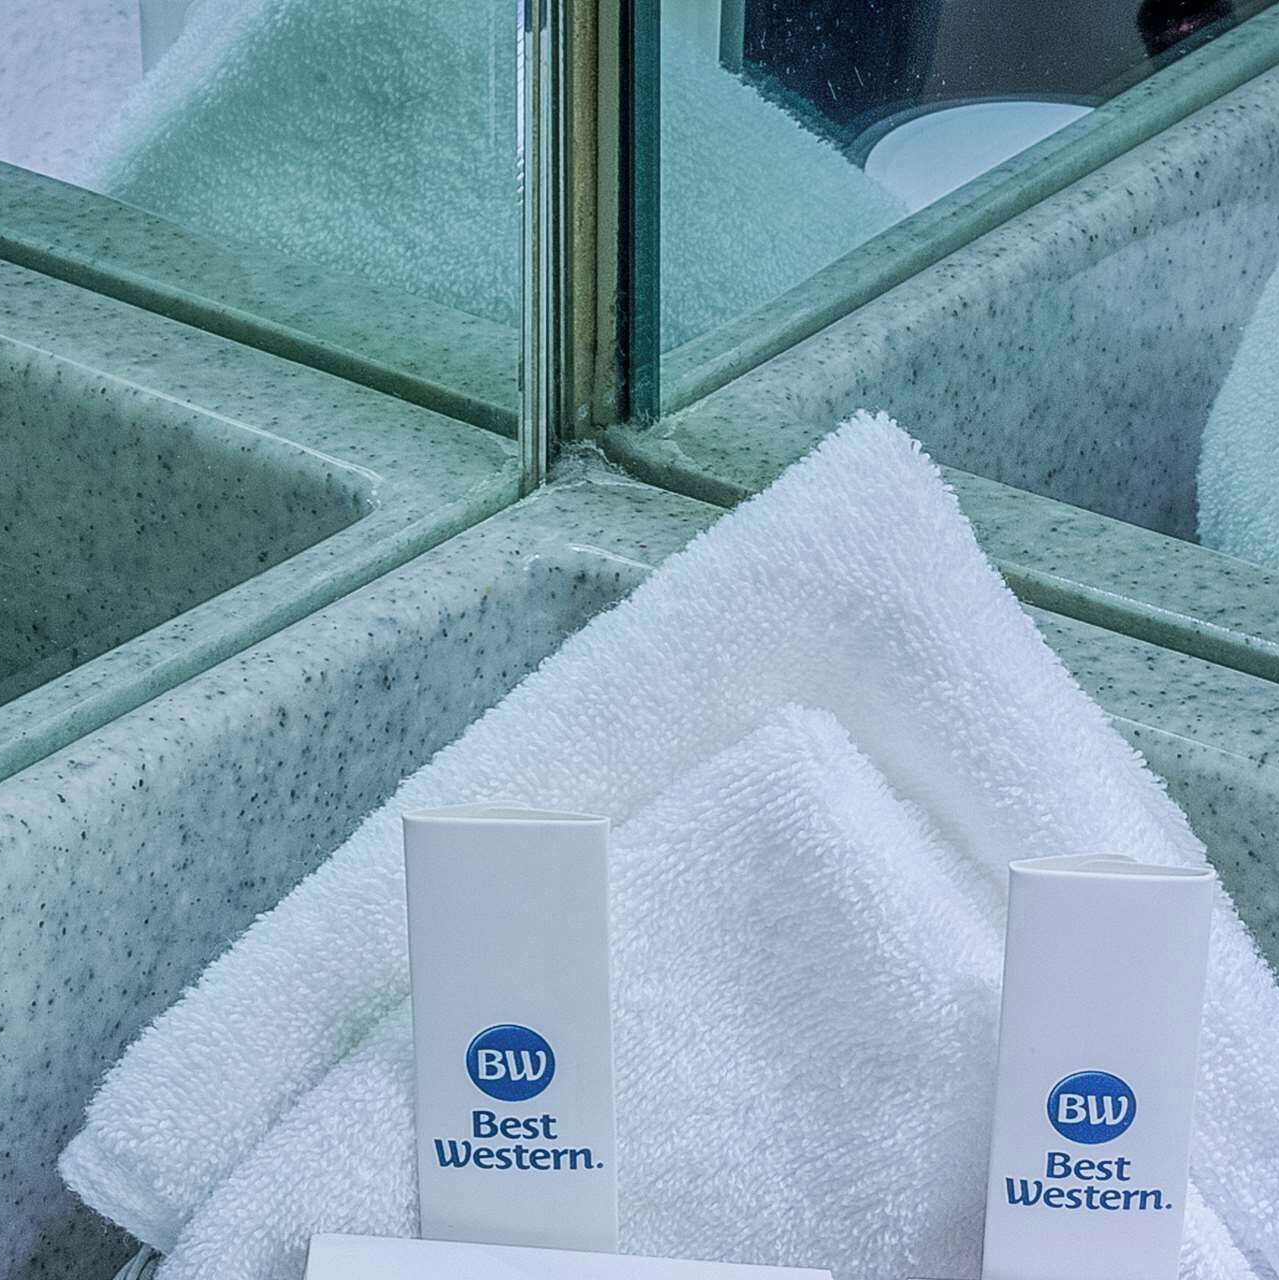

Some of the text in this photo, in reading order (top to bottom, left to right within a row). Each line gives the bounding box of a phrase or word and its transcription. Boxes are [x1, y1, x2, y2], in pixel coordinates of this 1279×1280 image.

[477, 1049, 547, 1081] BW
[472, 1110, 558, 1140] Best
[1057, 1093, 1129, 1126] BW
[1046, 1151, 1131, 1181] Best
